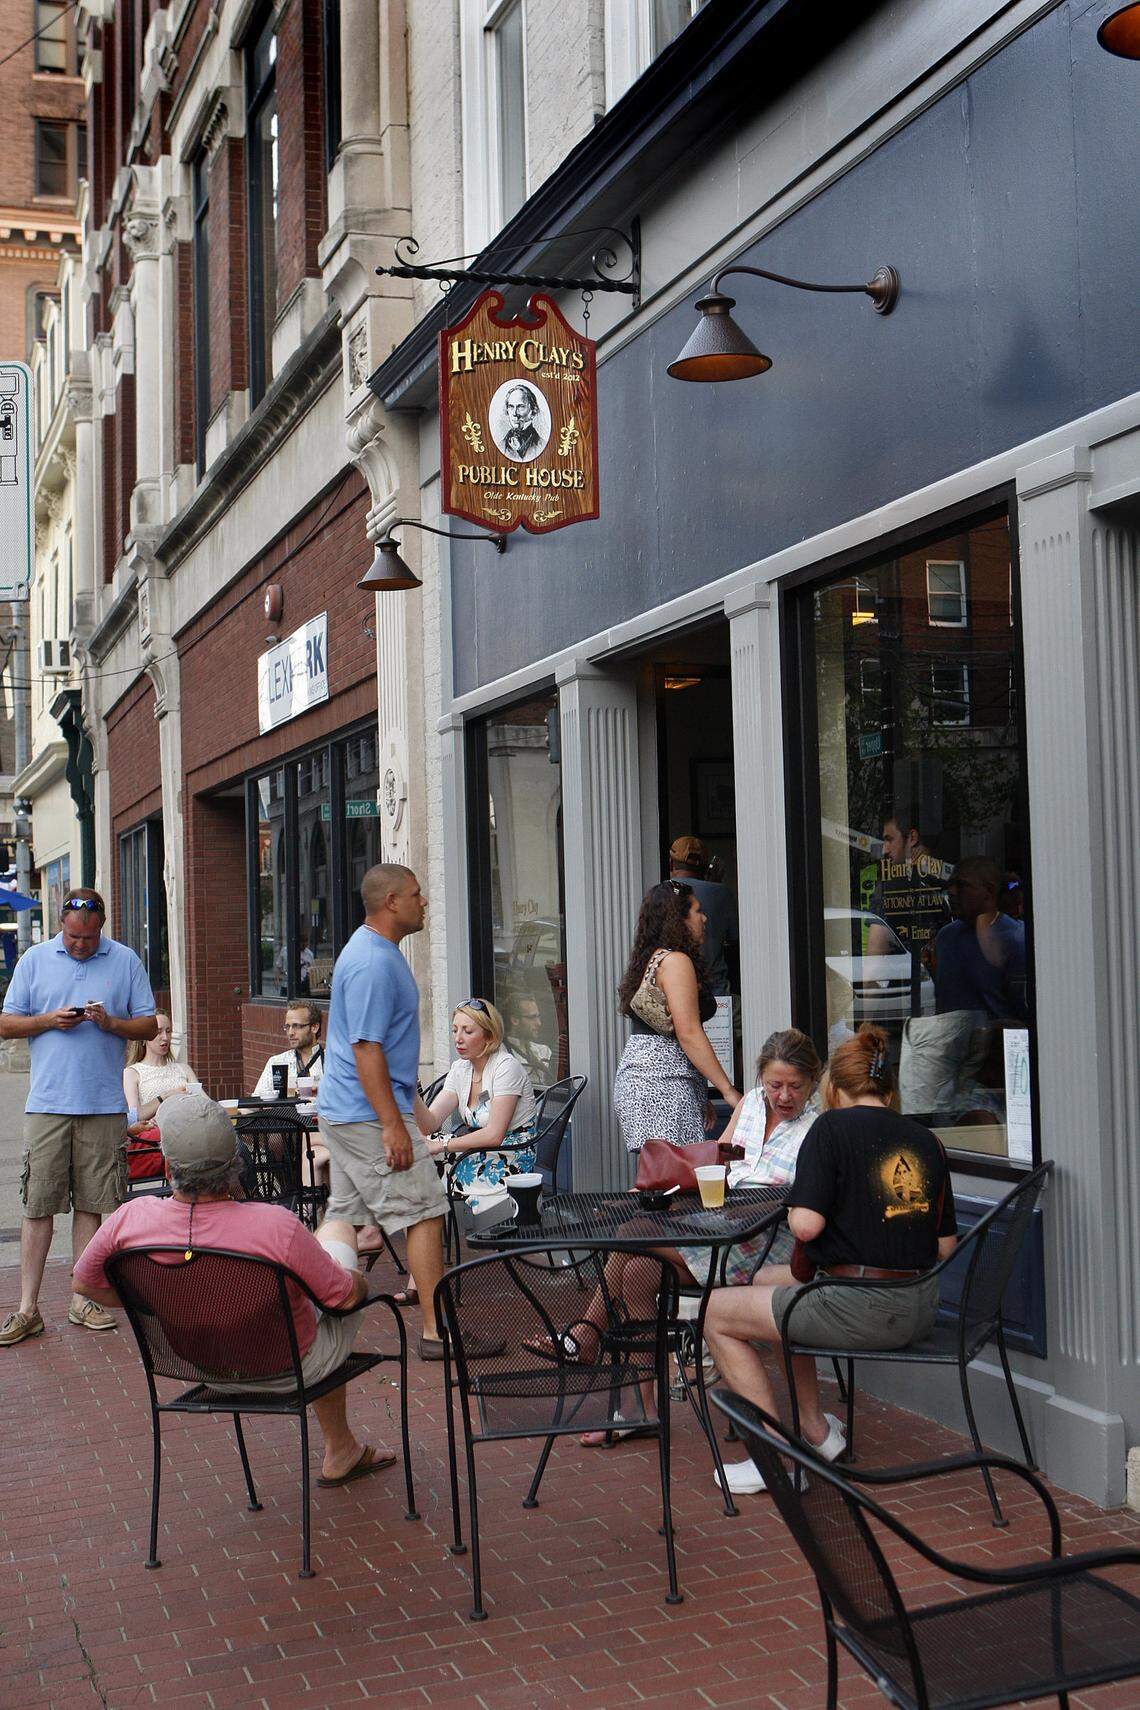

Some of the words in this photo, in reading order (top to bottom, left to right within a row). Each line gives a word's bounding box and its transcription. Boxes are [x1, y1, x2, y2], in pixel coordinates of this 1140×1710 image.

[451, 339, 518, 373] HENRY
[563, 373, 580, 382] 2012
[458, 464, 518, 486] PUBLIC
[526, 467, 585, 488] HOUSE
[483, 491, 503, 501] Olde
[505, 492, 541, 503] Kentucky
[543, 493, 560, 502] Pub
[269, 631, 325, 704] LEXRK
[881, 858, 913, 881] Henry
[917, 854, 943, 879] Clay
[883, 896, 914, 909] ATTORNEY
[917, 895, 926, 907] AT
[927, 893, 945, 906] LAW
[912, 925, 931, 940] Enter
